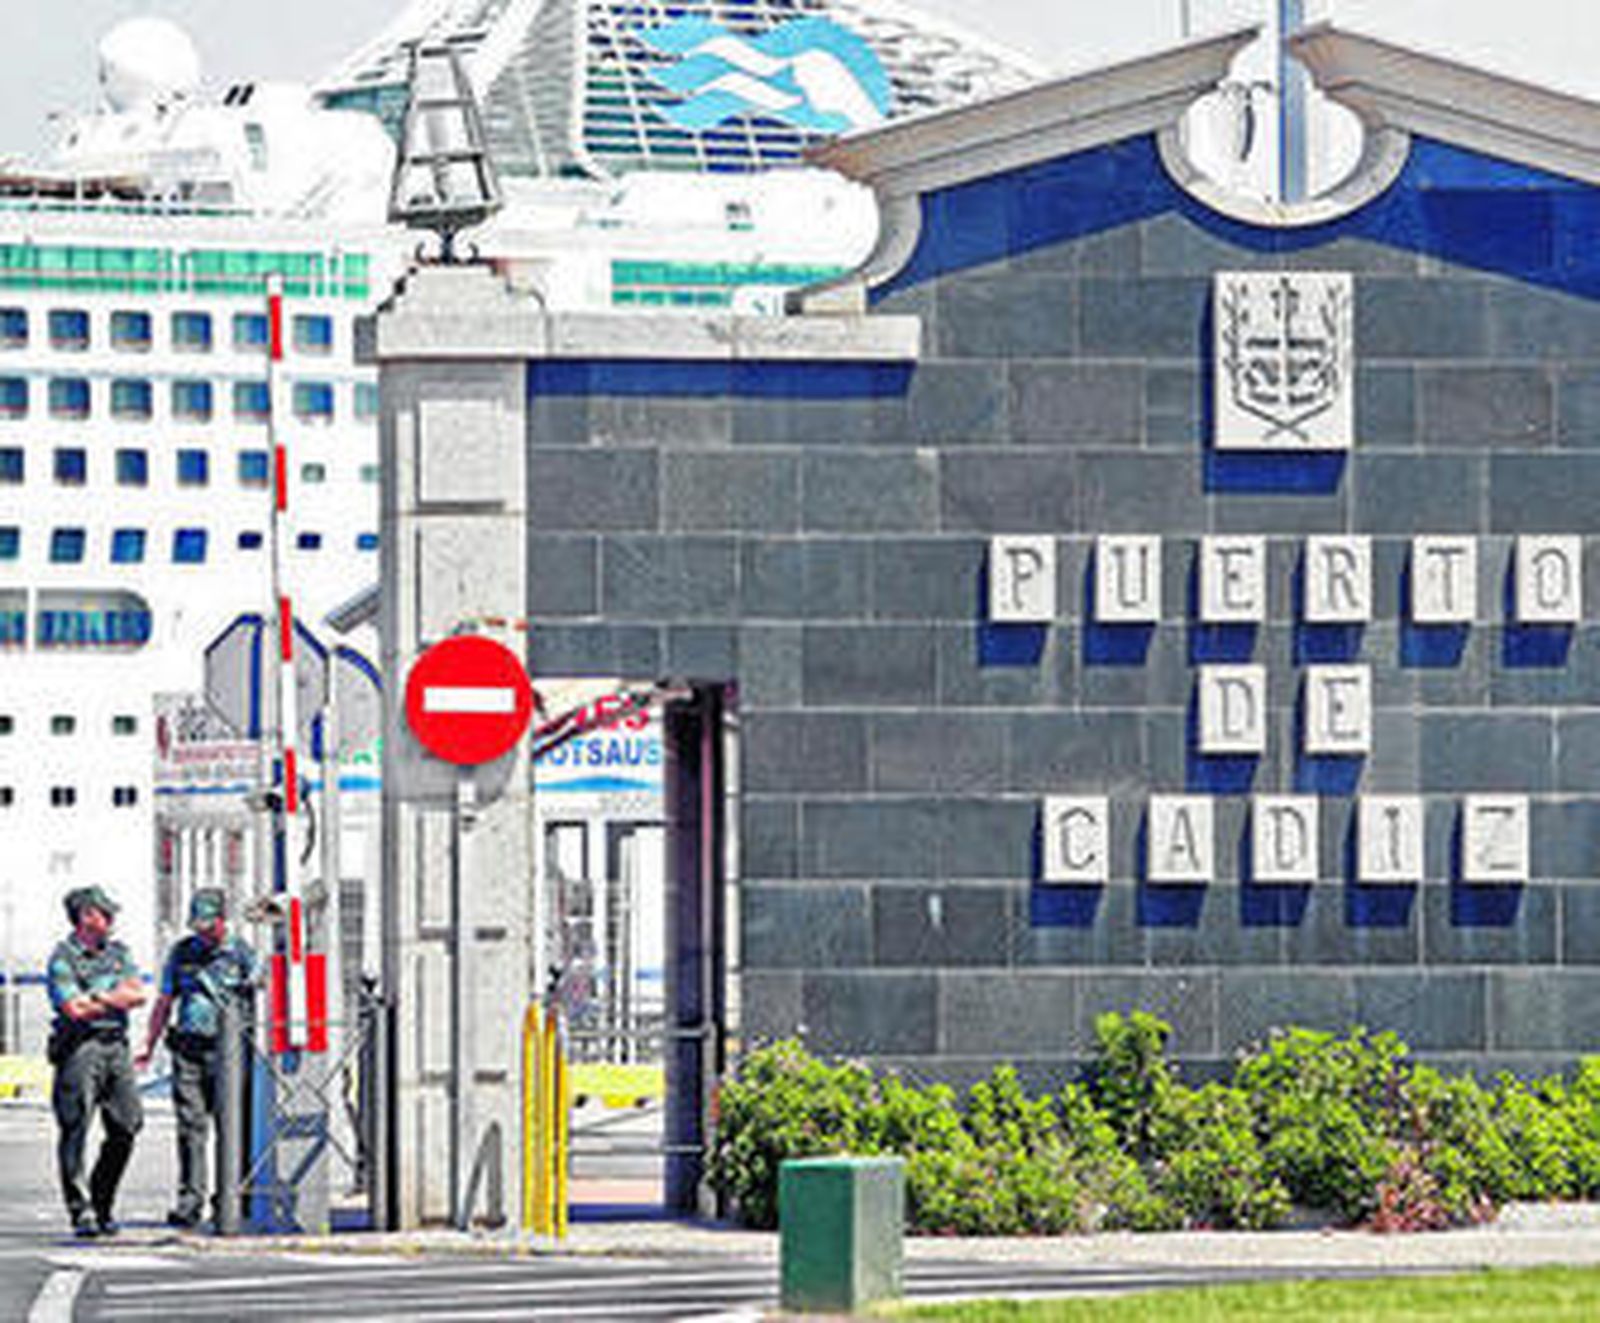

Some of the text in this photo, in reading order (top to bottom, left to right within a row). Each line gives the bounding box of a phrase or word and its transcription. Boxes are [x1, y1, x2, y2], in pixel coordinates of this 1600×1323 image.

[1004, 544, 1573, 613] PUERTO
[1214, 675, 1364, 743] DE
[1057, 804, 1522, 871] CADIZ
